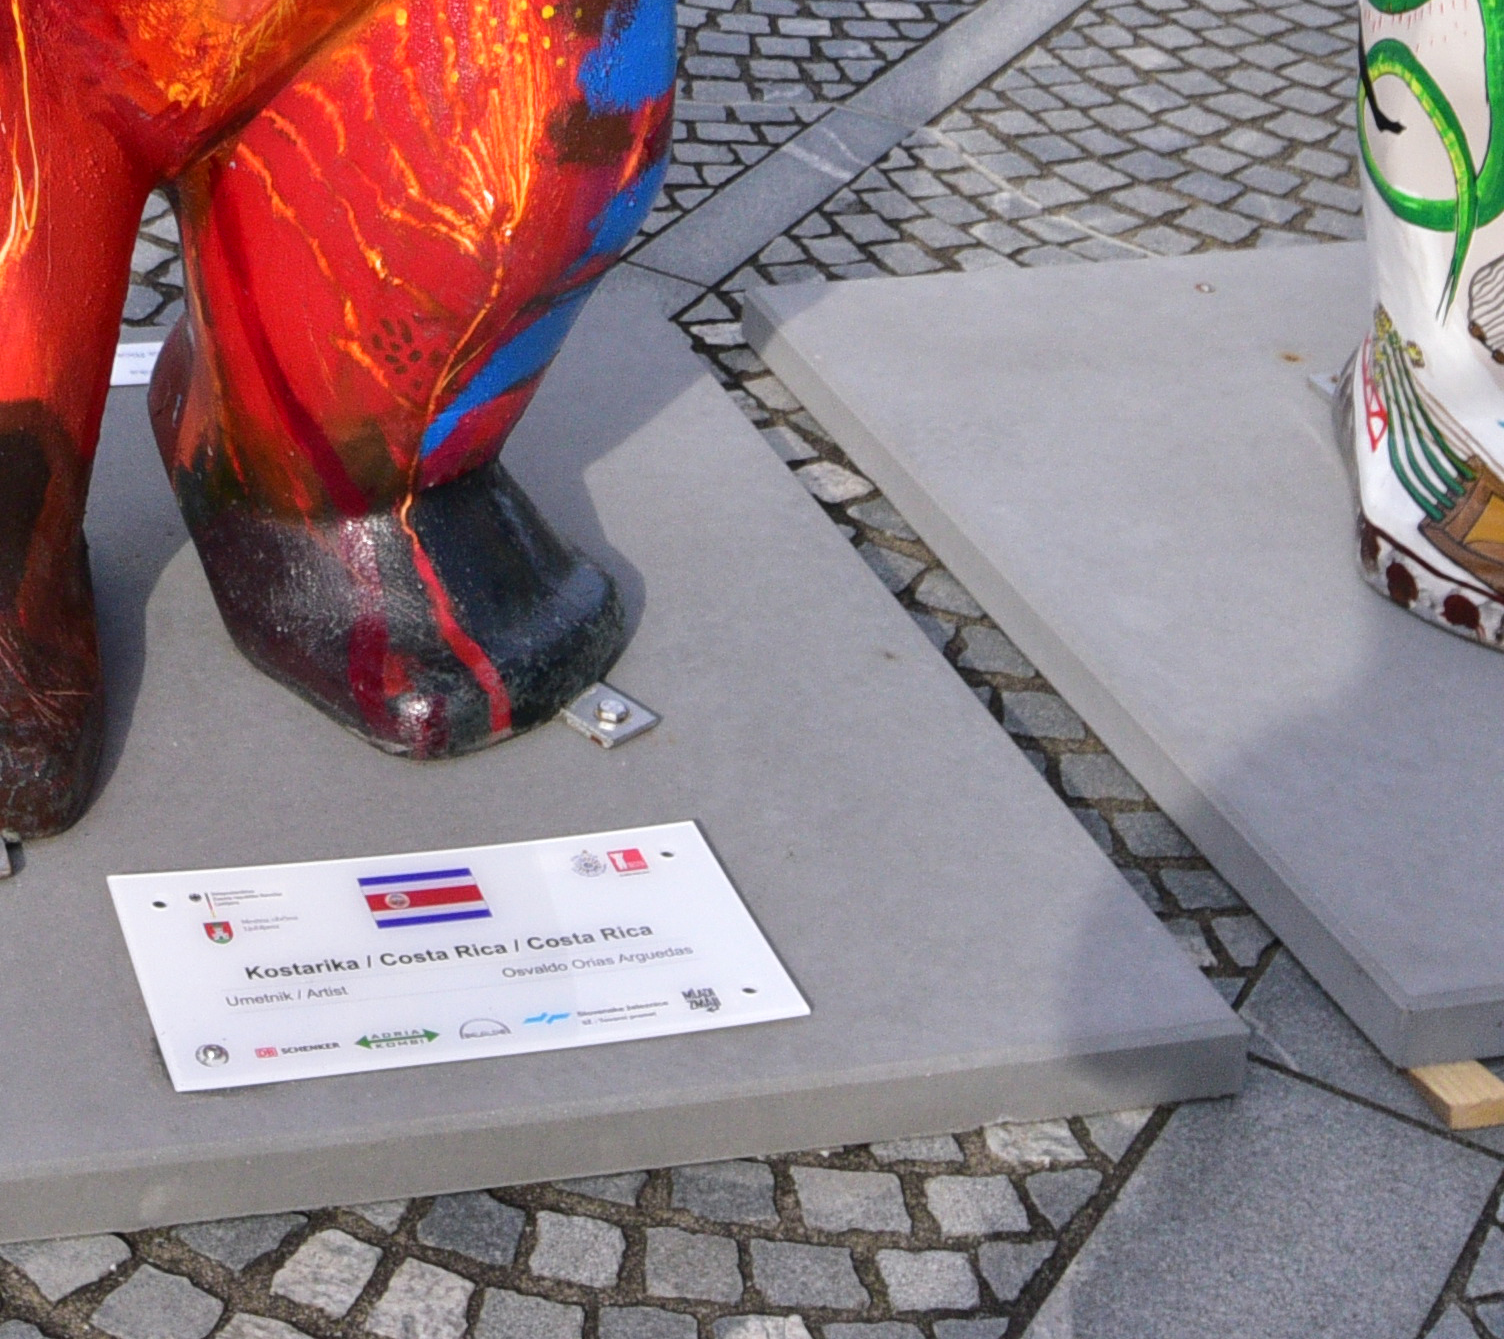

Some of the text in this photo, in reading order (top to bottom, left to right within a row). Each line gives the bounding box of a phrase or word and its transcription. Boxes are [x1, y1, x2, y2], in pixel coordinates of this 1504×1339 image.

[244, 958, 360, 980] Kostarika
[380, 949, 449, 966] Costa
[455, 942, 508, 959] Rica
[527, 930, 596, 950] Costa
[600, 924, 654, 941] Rica
[501, 961, 569, 978] Osvaldo
[618, 945, 694, 964] Arguedas
[225, 990, 293, 1007] Umetnik
[307, 985, 349, 999] Artist
[371, 1029, 420, 1039] ADRIA
[281, 1042, 341, 1055] SCHENKER
[375, 1039, 425, 1049] KOMBI
